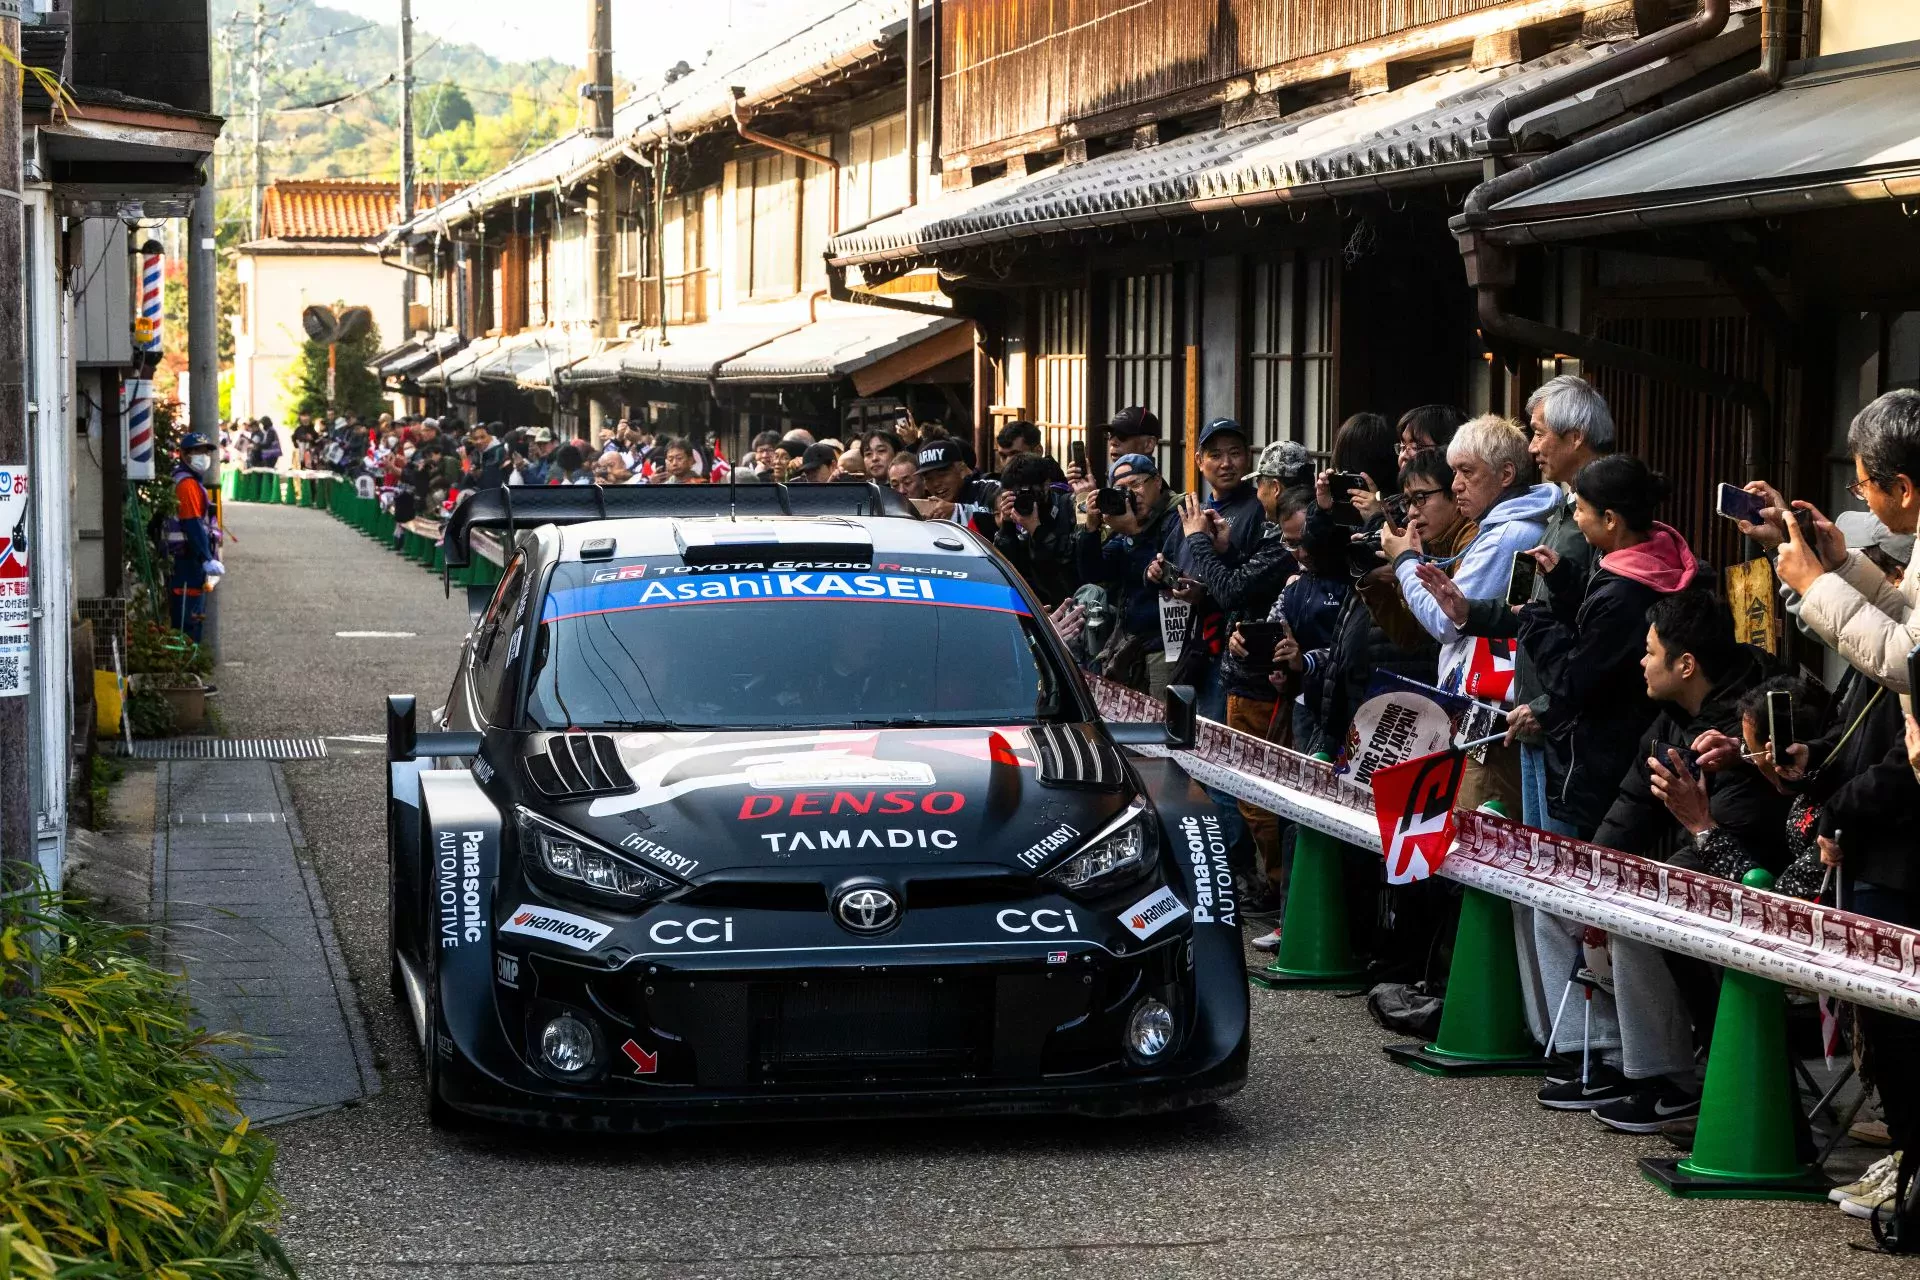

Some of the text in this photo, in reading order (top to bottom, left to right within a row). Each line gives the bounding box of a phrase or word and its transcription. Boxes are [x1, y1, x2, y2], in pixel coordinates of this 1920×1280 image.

[918, 448, 945, 465] ARMY
[594, 568, 643, 583] GR
[654, 561, 968, 579] TOYOTA GAZOO Racing
[639, 574, 935, 602] AsahiKASEI
[1163, 605, 1188, 619] WRC
[1166, 631, 1186, 642] 202
[1388, 708, 1419, 751] JAPAN
[1354, 751, 1380, 785] WRC
[737, 791, 966, 820] DENSO
[761, 829, 958, 852] TAMADIC
[1179, 816, 1214, 923] Panasonic
[1202, 815, 1236, 926] AUTOMOTIVE
[439, 831, 459, 948] AUTOMOTIVE
[462, 831, 486, 943] Panasonic
[497, 955, 519, 983] OMP
